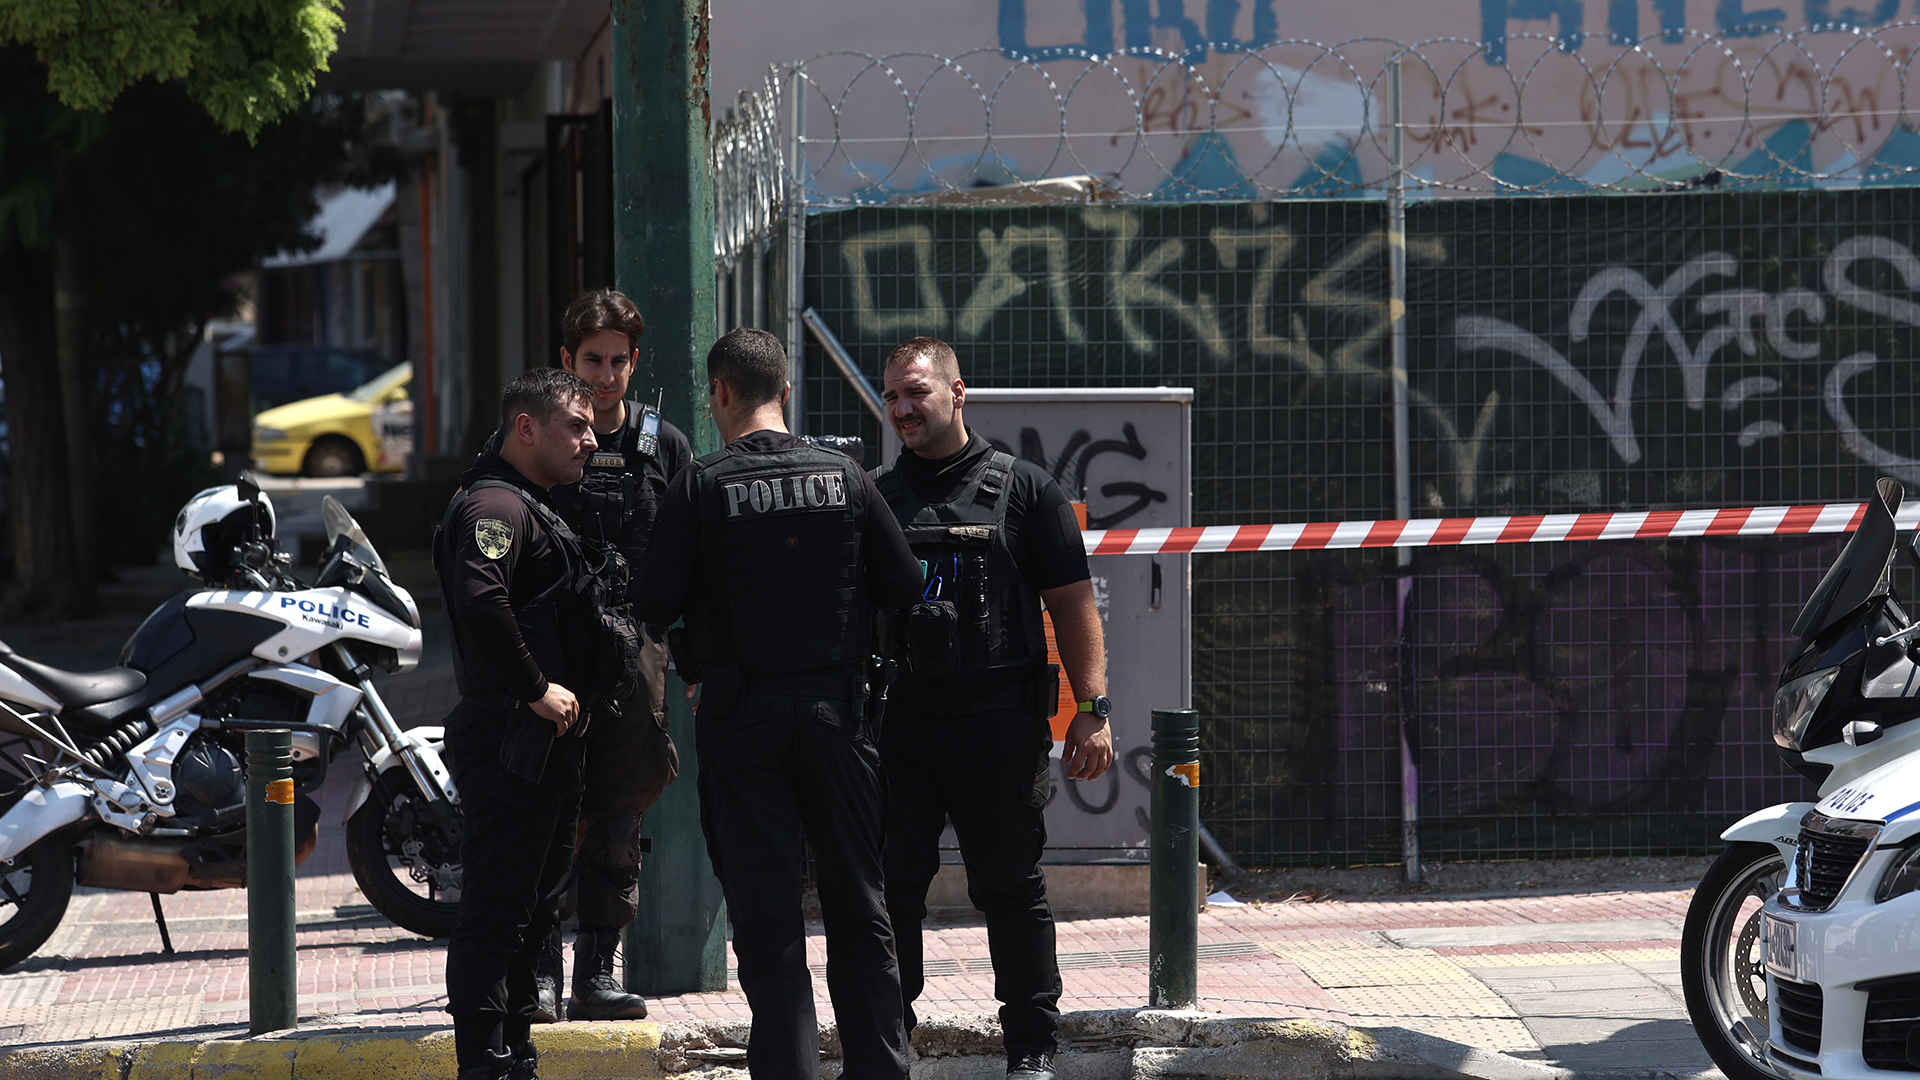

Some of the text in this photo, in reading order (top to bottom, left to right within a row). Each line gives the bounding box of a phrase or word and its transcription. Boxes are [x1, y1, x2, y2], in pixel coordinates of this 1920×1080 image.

[724, 474, 847, 518] POLICE
[280, 597, 370, 629] POLICE
[302, 613, 344, 630] Kawasaki
[1824, 788, 1875, 813] POLICE
